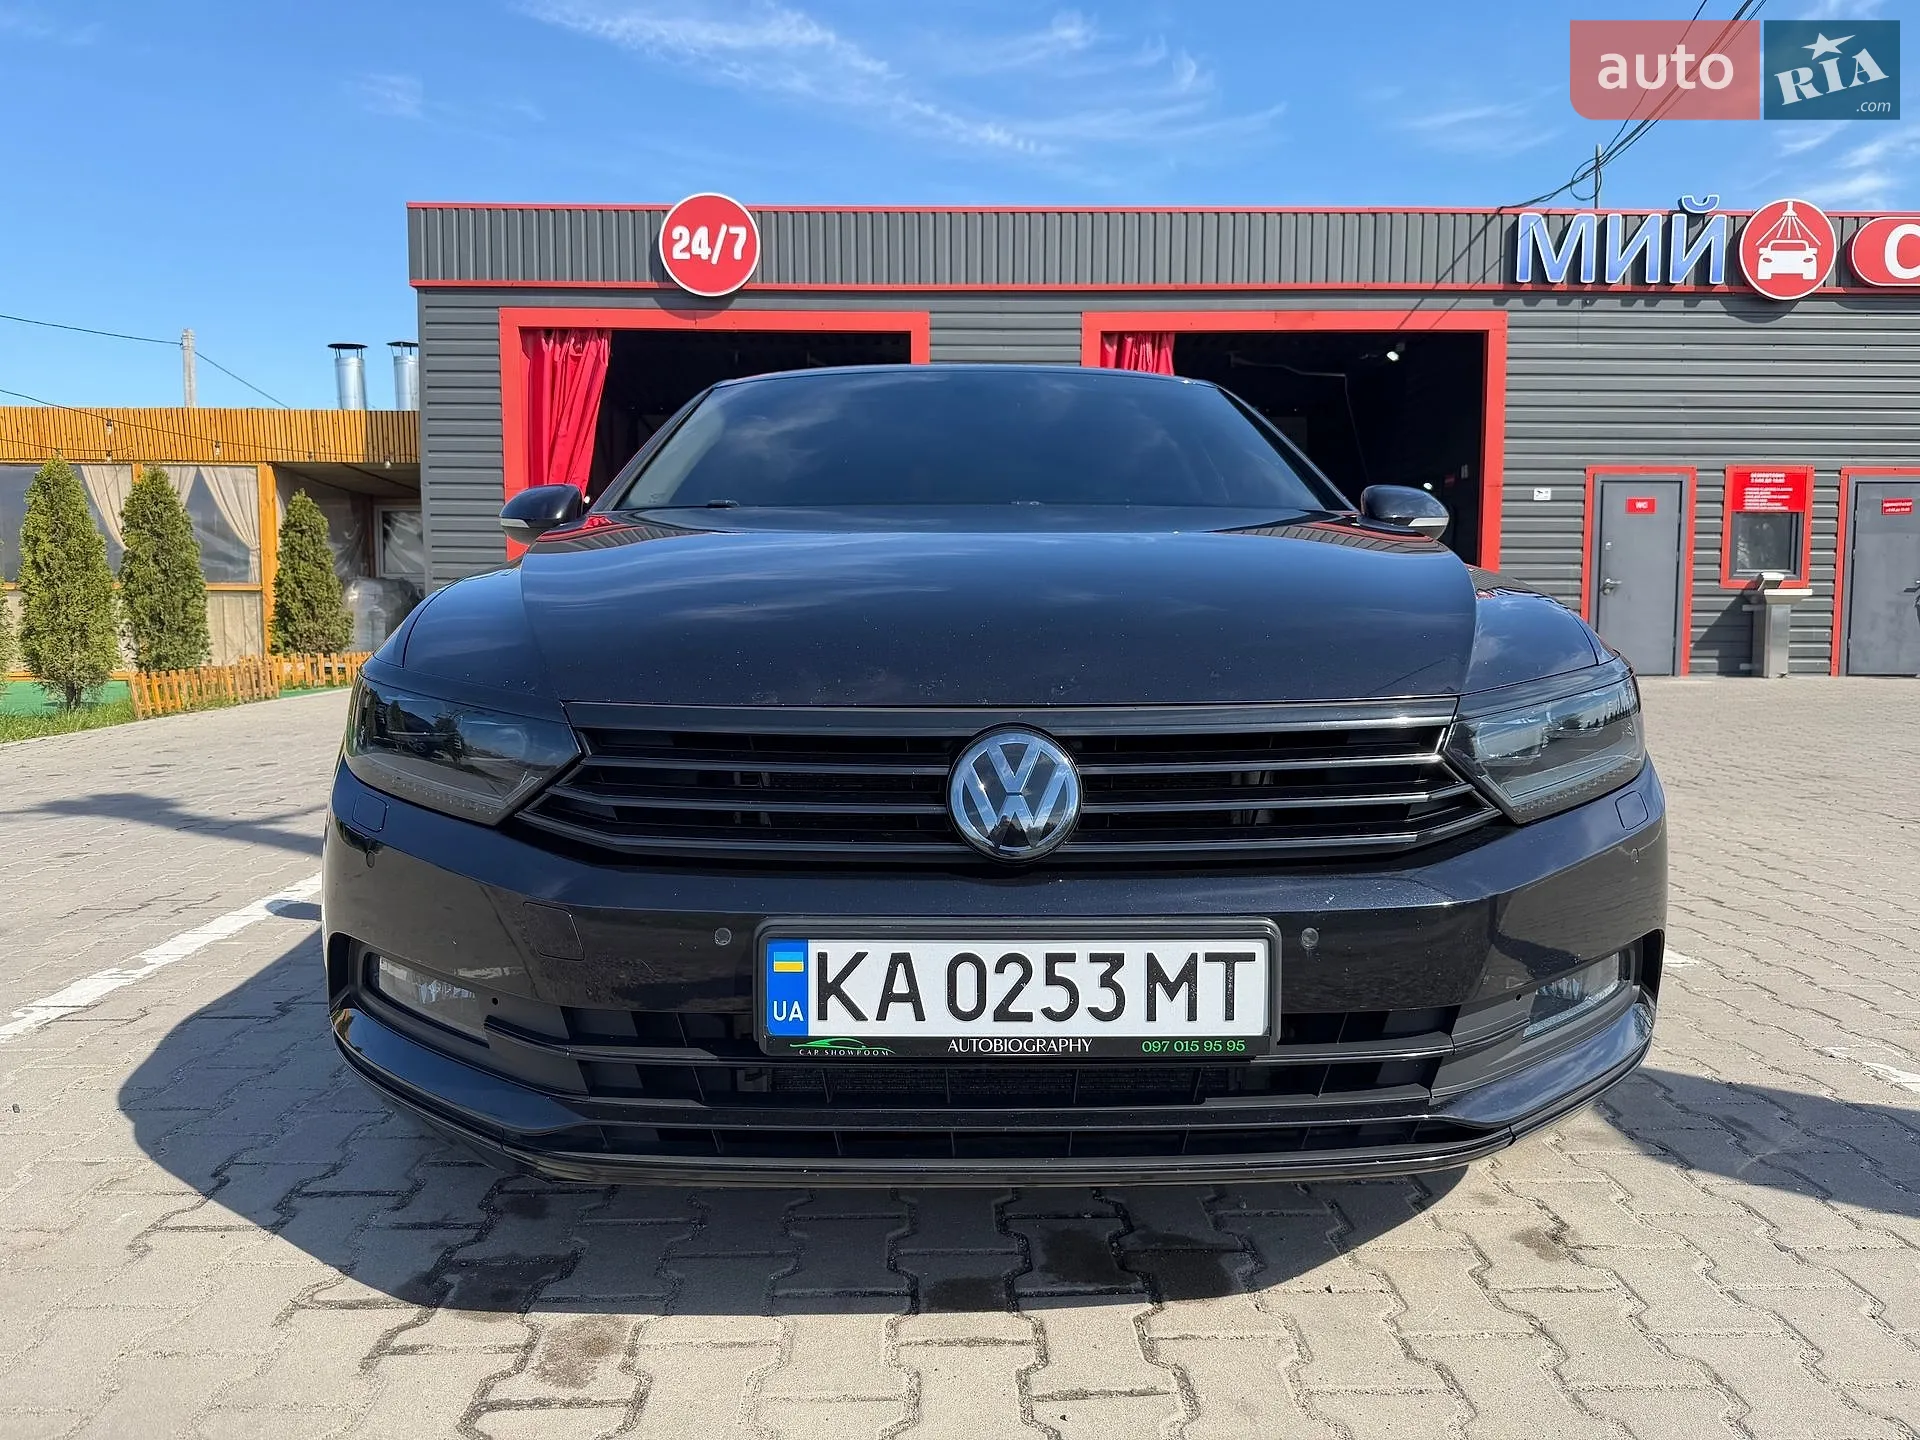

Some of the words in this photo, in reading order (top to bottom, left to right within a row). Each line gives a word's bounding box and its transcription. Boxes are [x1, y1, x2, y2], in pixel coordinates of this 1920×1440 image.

[671, 223, 747, 265] 24/7
[1515, 194, 1728, 284] МИЙ
[773, 1000, 805, 1022] UA
[816, 951, 927, 1023] KA
[945, 951, 1126, 1023] 0253
[1146, 951, 1257, 1022] MT
[947, 1038, 1093, 1053] AUTOBIOGRAPHY
[1141, 1040, 1170, 1053] 097
[1173, 1040, 1200, 1052] 015
[1203, 1040, 1223, 1052] 95
[1226, 1039, 1246, 1052] 95
